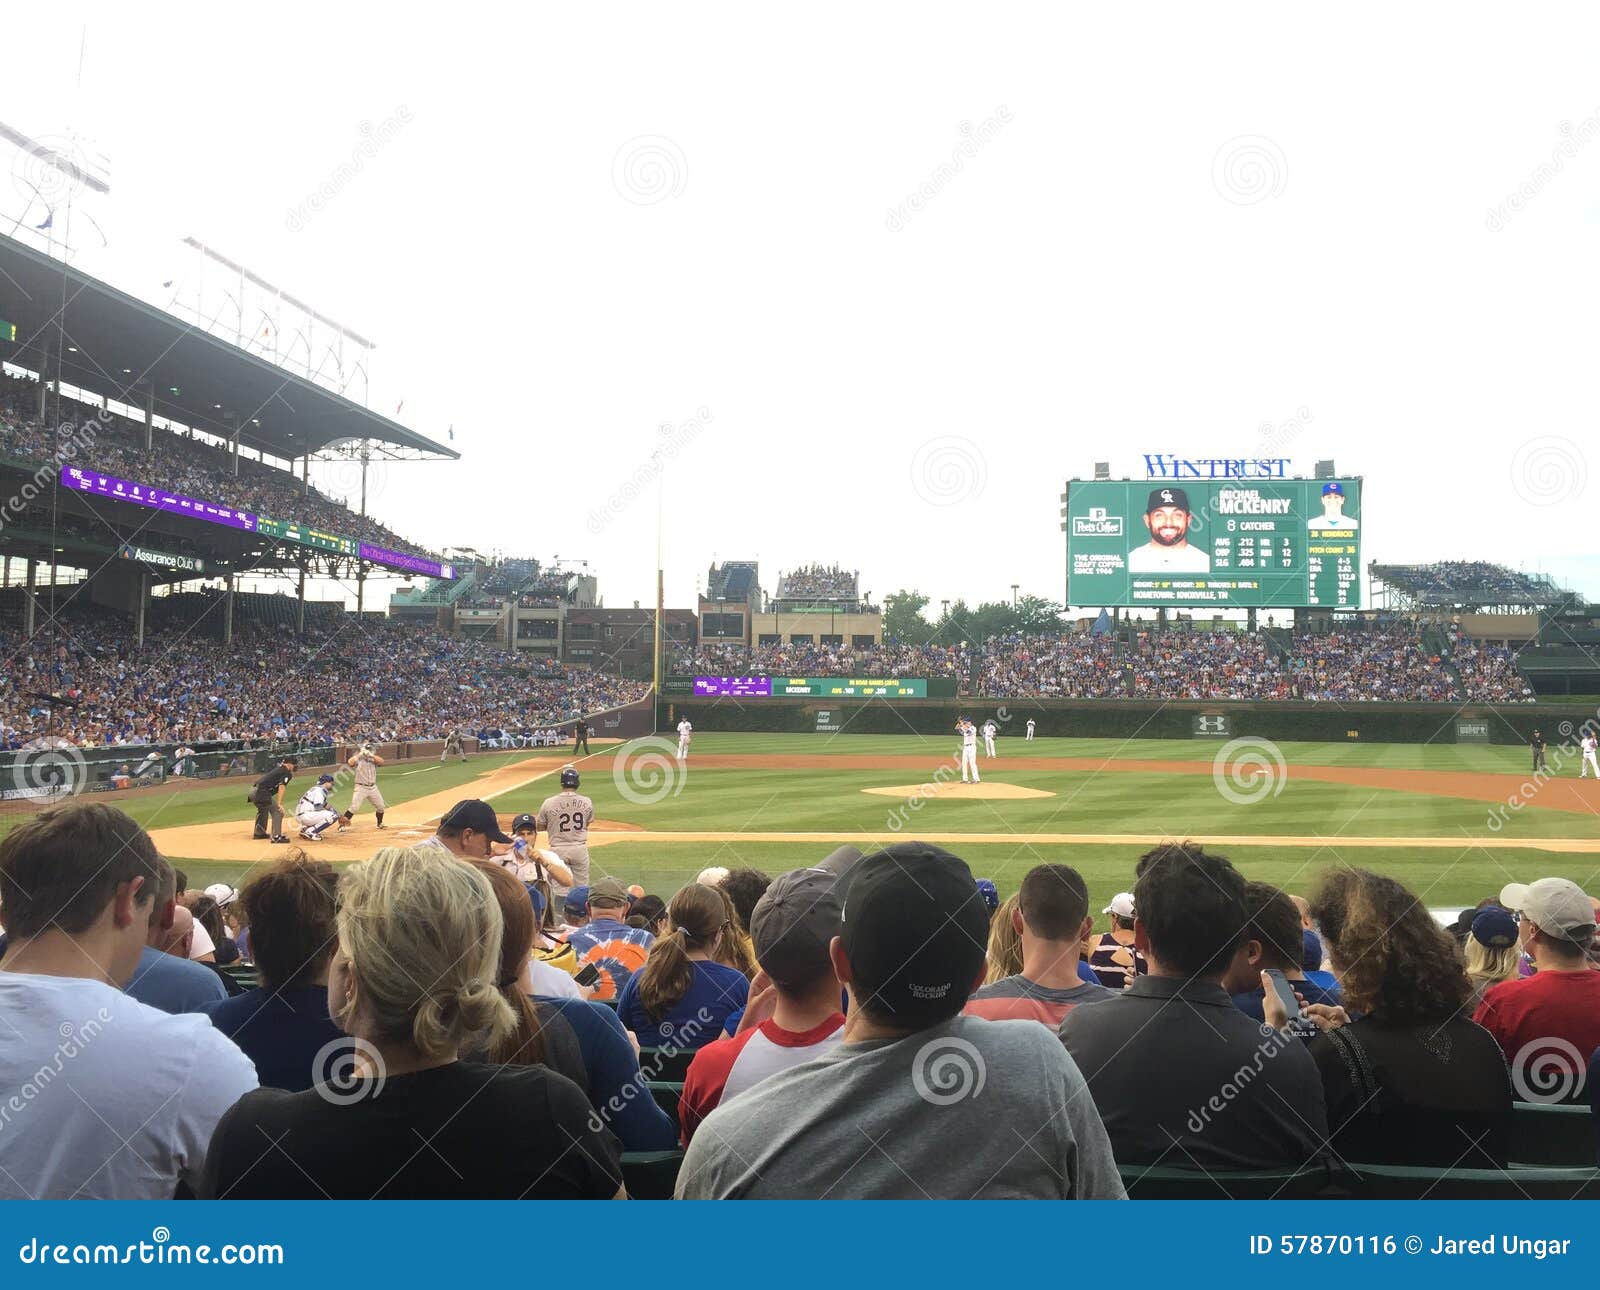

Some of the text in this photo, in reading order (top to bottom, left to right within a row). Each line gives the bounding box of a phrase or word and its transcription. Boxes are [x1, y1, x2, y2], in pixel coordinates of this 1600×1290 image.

[1143, 454, 1291, 478] WINTRUST
[1220, 490, 1259, 499] MICHAEL
[1220, 499, 1291, 514] MCKENRY
[1096, 521, 1119, 533] Coffee
[1227, 520, 1275, 531] 8 CATCHER
[1215, 538, 1230, 546] AVG
[134, 548, 194, 570] Assurance Club
[560, 812, 584, 832] 29
